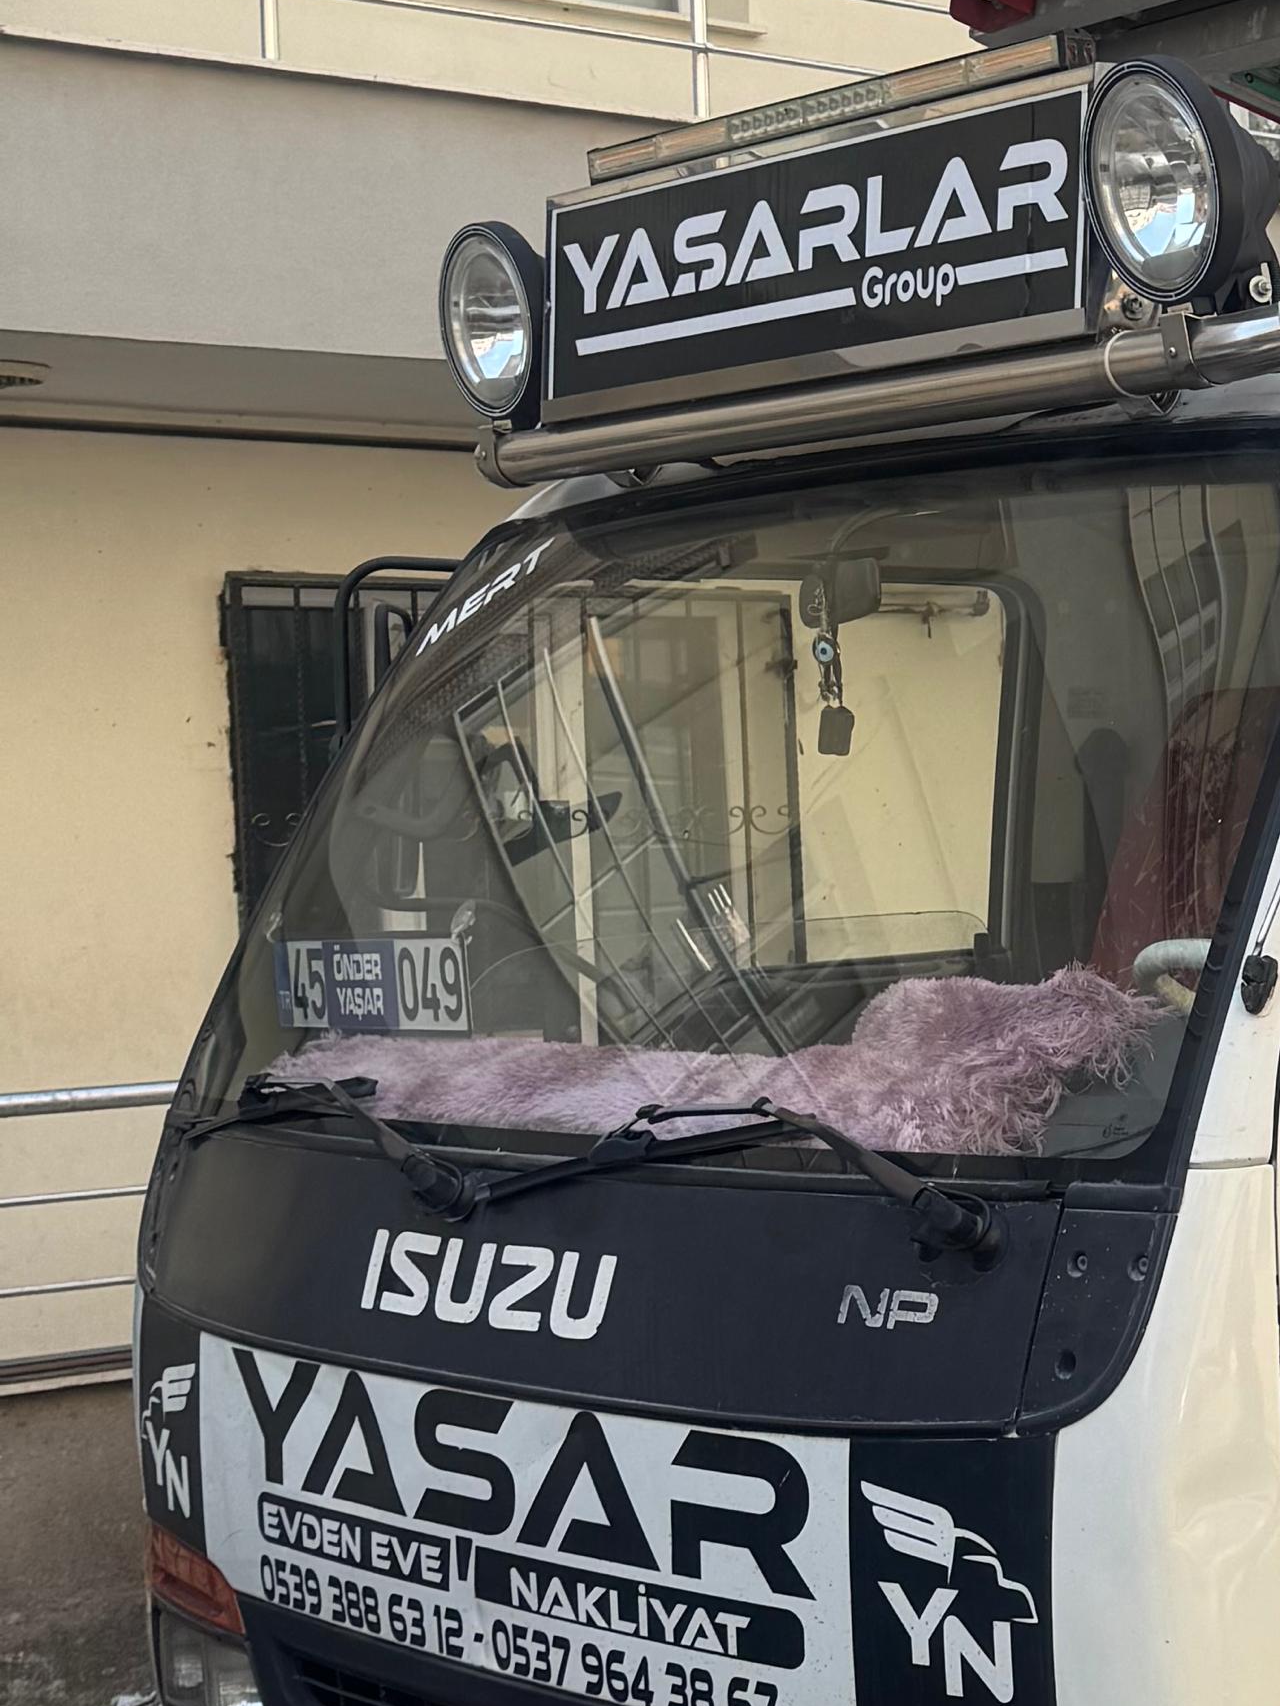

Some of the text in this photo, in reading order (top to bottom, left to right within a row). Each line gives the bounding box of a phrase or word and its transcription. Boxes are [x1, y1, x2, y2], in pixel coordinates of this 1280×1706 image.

[861, 262, 956, 309] Group
[415, 537, 555, 657] MERT
[294, 948, 327, 1021] 45
[332, 945, 382, 981] ÖNDER
[336, 987, 384, 1021] YAŞAR
[398, 946, 463, 1022] 049
[360, 1228, 617, 1340] ISUZU
[837, 1284, 939, 1330] NP
[145, 1427, 190, 1519] YN
[261, 1554, 321, 1616] 0539
[329, 1577, 379, 1634] 388
[389, 1593, 426, 1650] 63
[433, 1603, 465, 1659] 12
[491, 1618, 571, 1687] 0537
[262, 1503, 751, 1658] EVDEN EVE NAKLİYAT
[877, 1580, 1013, 1704] YN
